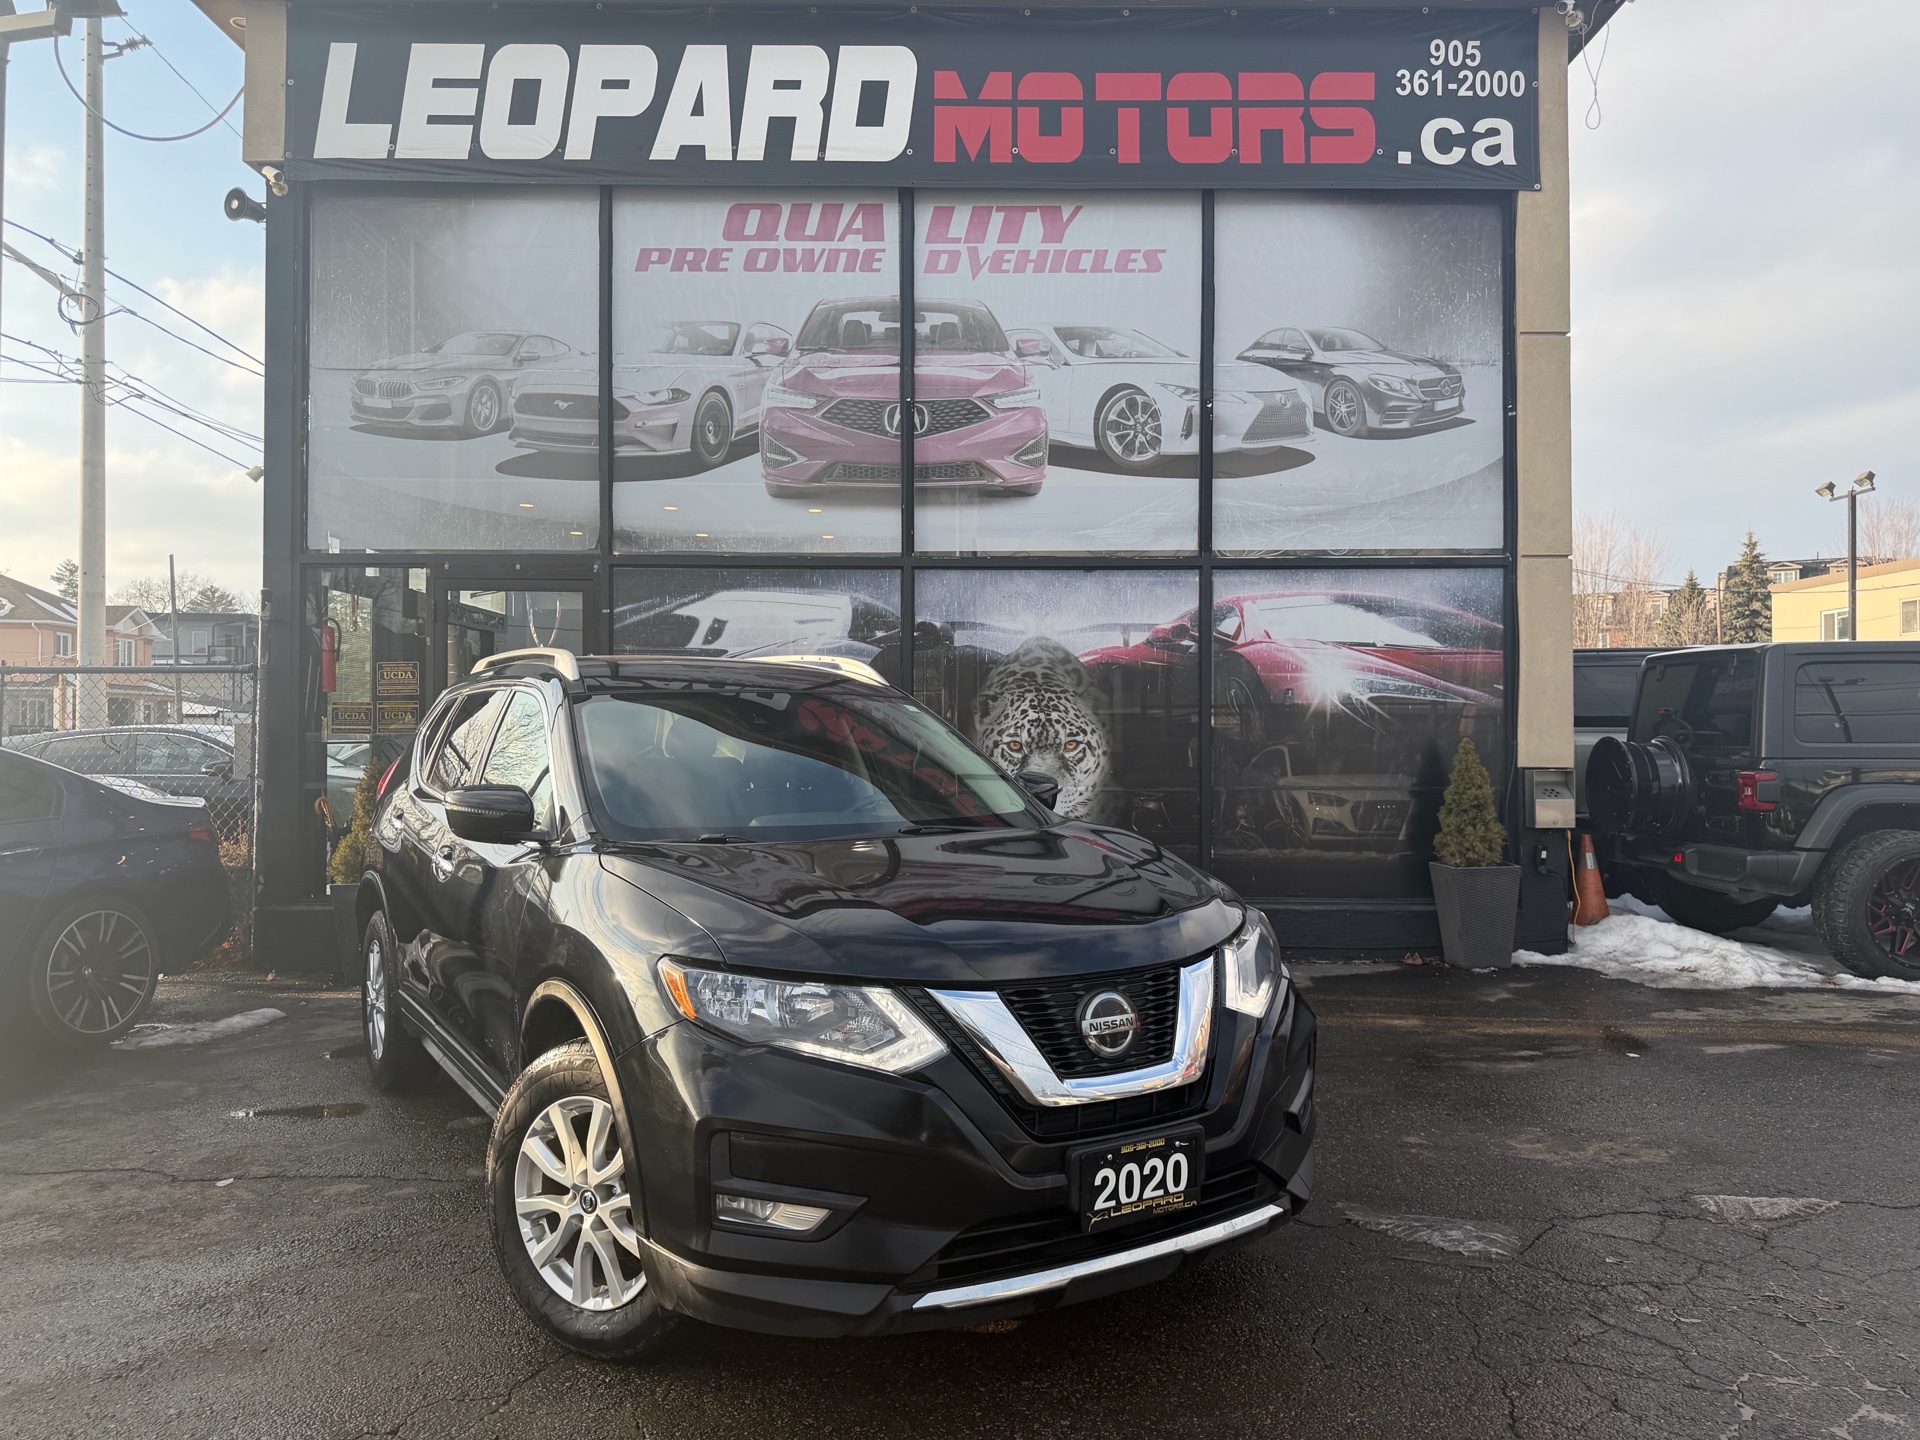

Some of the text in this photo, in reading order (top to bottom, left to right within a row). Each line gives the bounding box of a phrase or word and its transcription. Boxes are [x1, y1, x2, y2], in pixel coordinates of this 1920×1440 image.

[1429, 39, 1482, 67] 905
[1395, 69, 1526, 97] 361-2000
[313, 42, 1518, 166] LEOPARD MOTORS .ca
[722, 203, 1084, 244] QUA LITY
[634, 247, 734, 272] PRE
[743, 248, 887, 273] OWNE
[383, 671, 413, 679] UCDA
[338, 712, 366, 720] UCDA
[1089, 1016, 1134, 1033] NISSAN
[1121, 1138, 1165, 1154] 905-361-2000
[1094, 1153, 1189, 1211] 2020
[1110, 1192, 1185, 1217] LEOPARD
